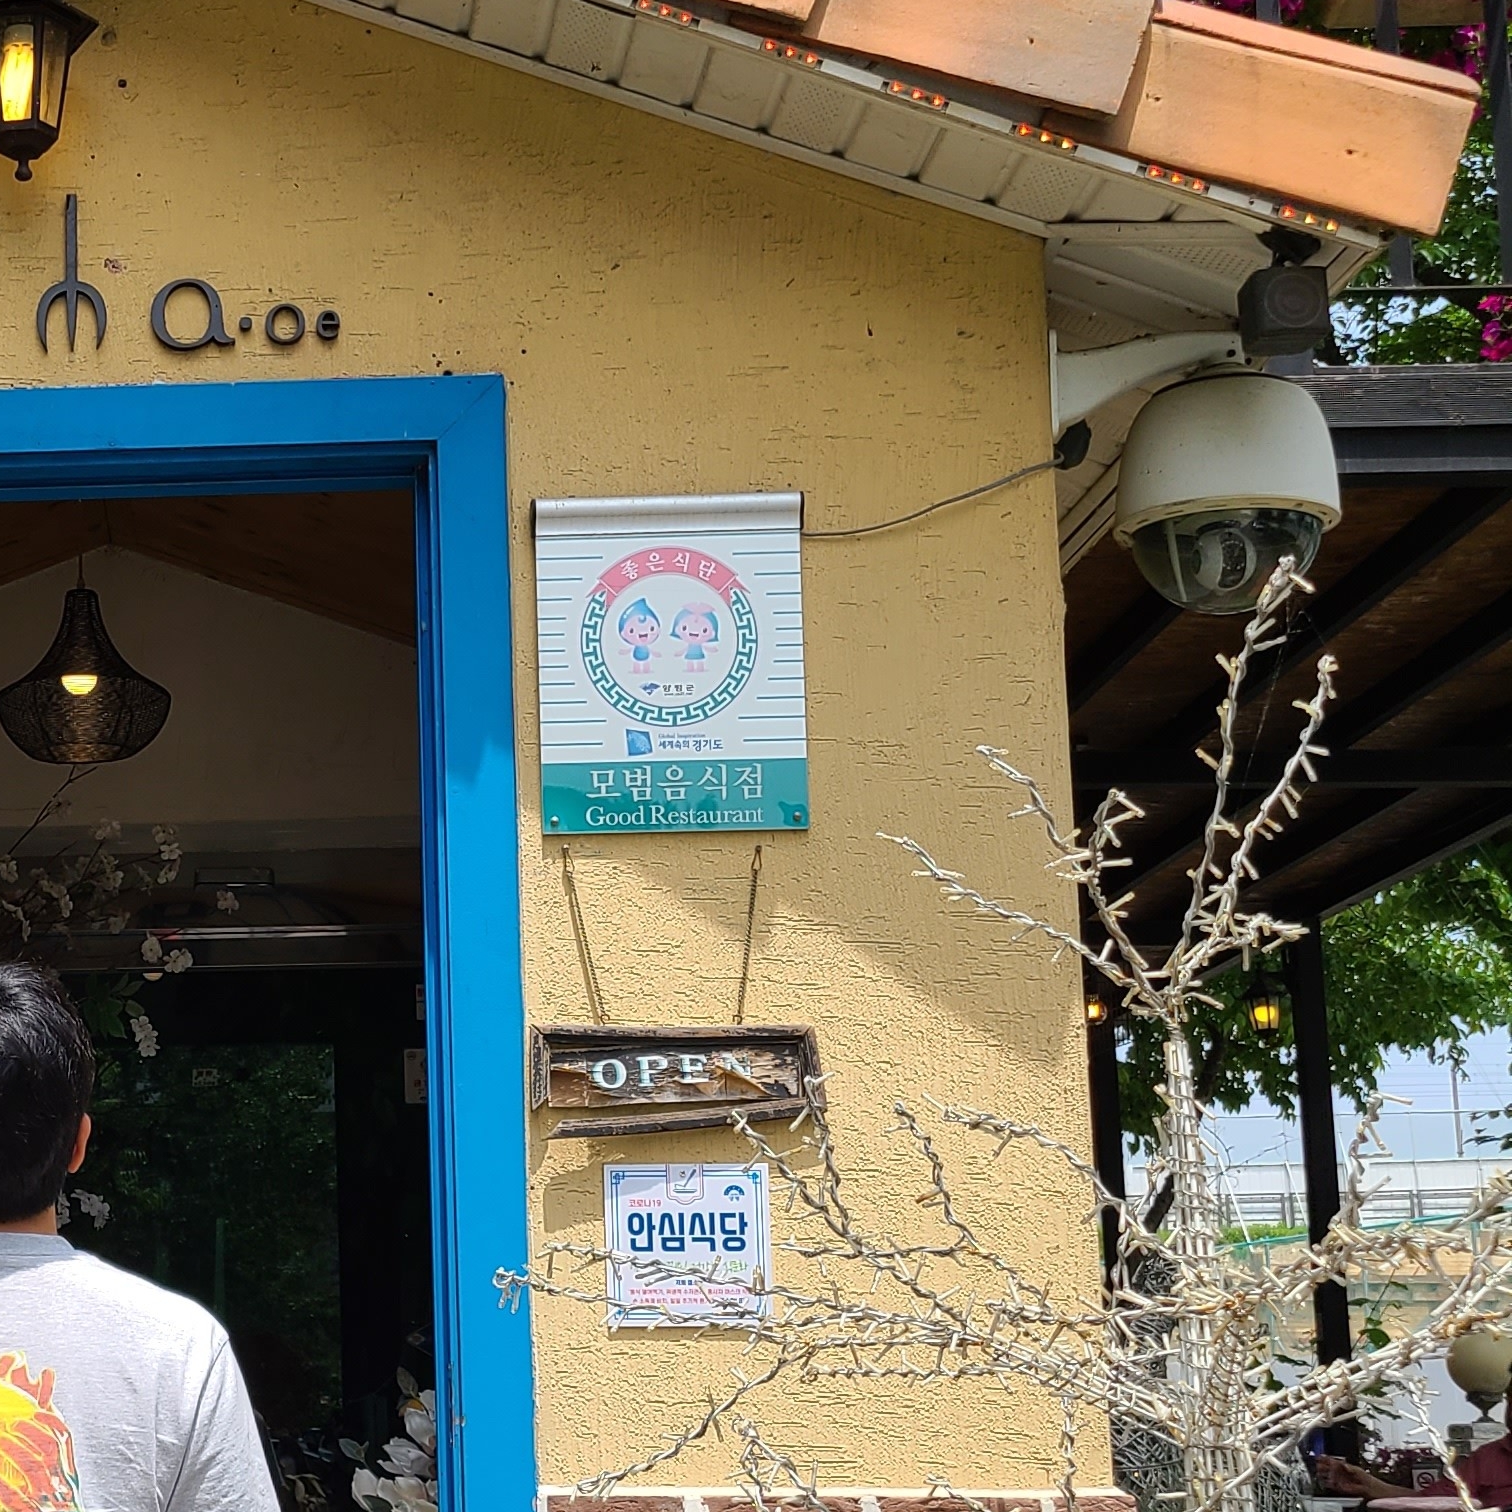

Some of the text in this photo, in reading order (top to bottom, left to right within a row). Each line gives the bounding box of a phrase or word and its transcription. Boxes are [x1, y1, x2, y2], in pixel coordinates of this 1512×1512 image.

[621, 552, 717, 579] 좋은식단
[692, 739, 724, 752] 경기도
[586, 763, 764, 801] 모범음식점
[586, 805, 764, 826] Good Restaurant
[589, 1052, 753, 1090] OPEN
[628, 1211, 748, 1252] 안심식당
